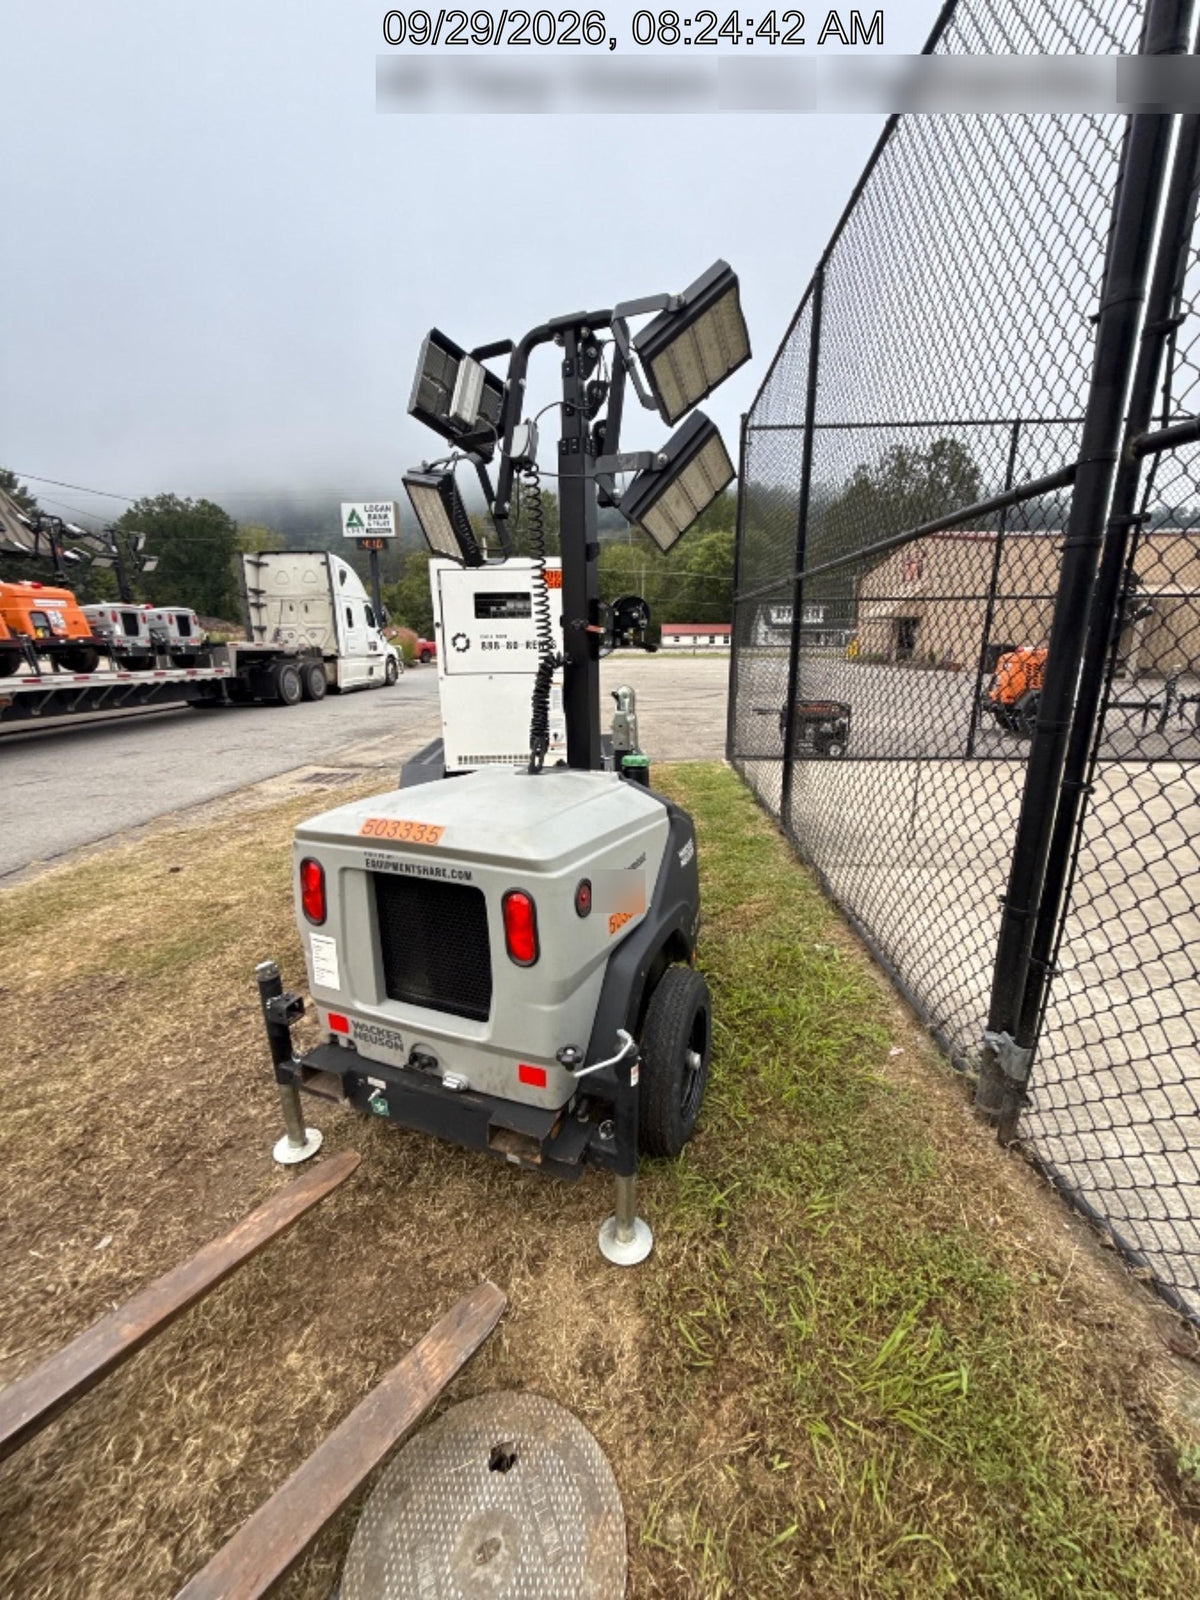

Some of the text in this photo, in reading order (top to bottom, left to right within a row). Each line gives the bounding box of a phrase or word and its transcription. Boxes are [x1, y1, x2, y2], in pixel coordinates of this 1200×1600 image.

[364, 504, 392, 513] LOGAN
[367, 513, 390, 521] BANK
[362, 818, 441, 844] 503335
[364, 858, 472, 881] EQUIPMENTSHARE.COM
[352, 1020, 402, 1042] WACKER
[353, 1030, 404, 1052] NEUSON
